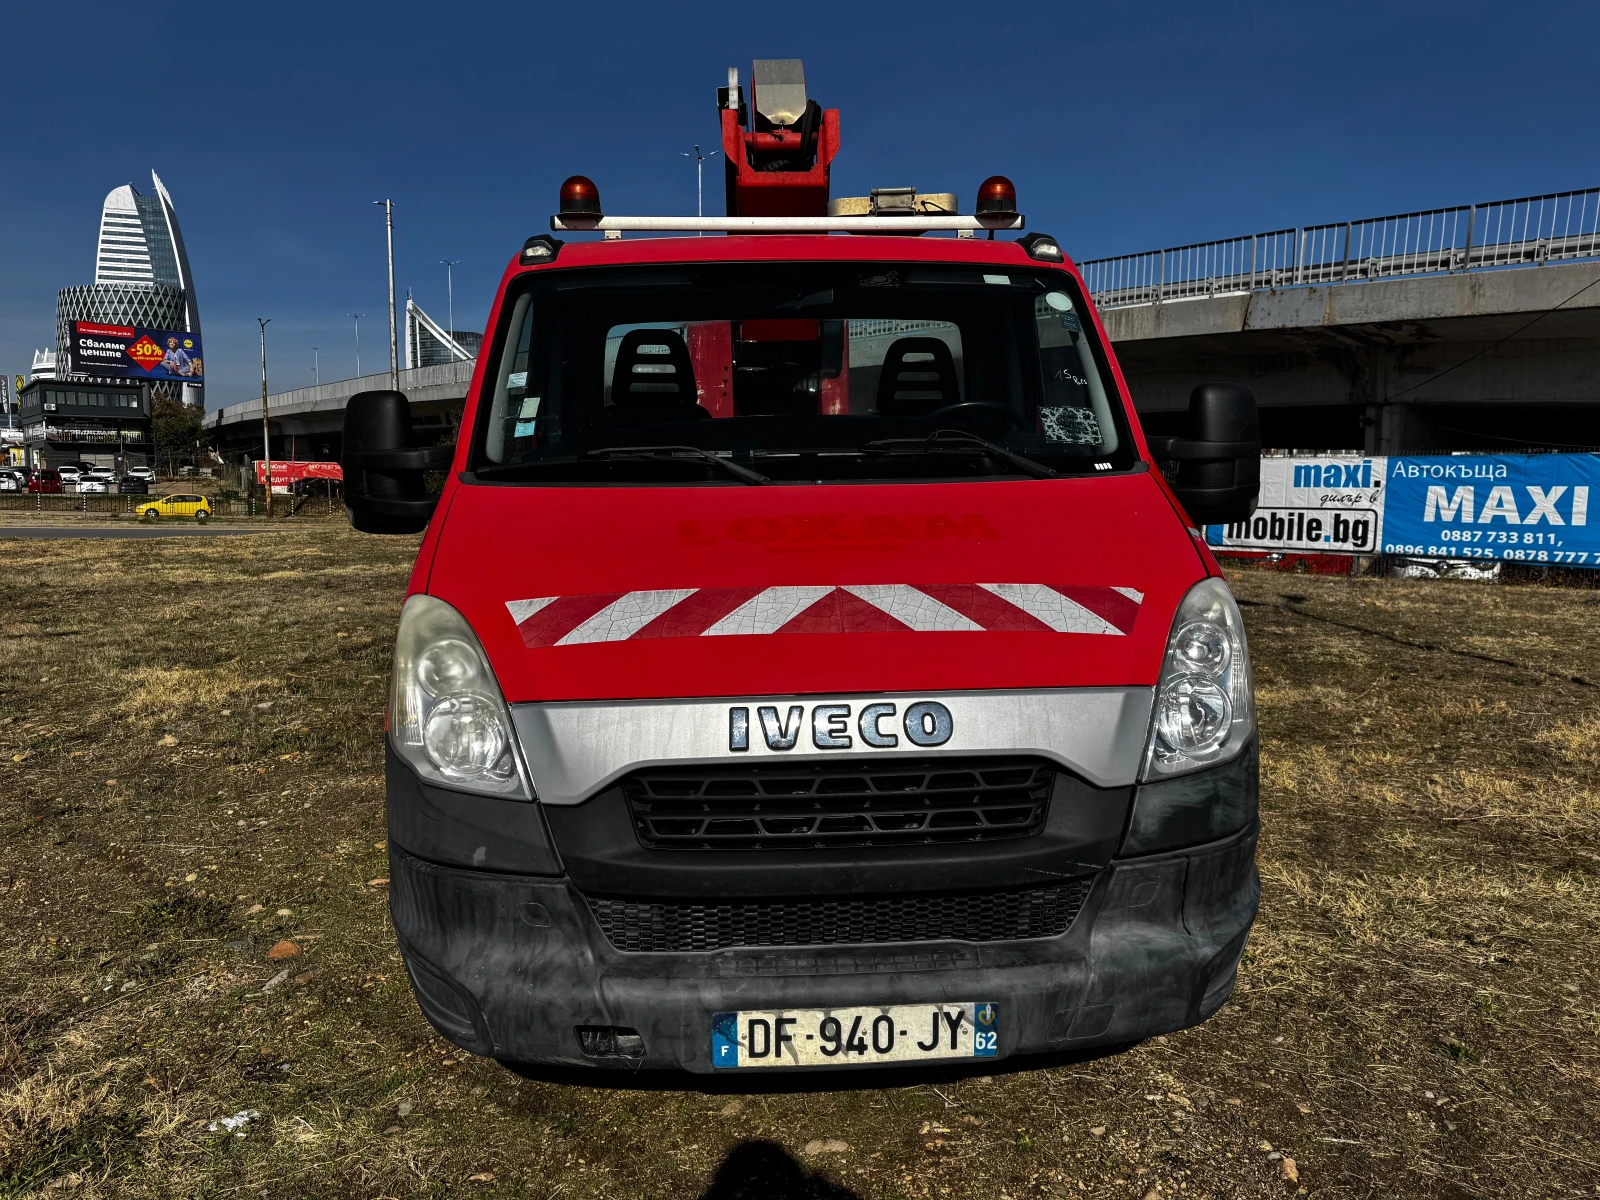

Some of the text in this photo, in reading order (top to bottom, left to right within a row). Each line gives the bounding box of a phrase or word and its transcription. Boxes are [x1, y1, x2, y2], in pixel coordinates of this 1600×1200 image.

[79, 338, 126, 350] Сваляме
[79, 348, 122, 358] цените
[131, 343, 163, 356] -50%
[261, 475, 289, 483] Кедит
[1392, 460, 1507, 481] Автокъща
[1423, 485, 1589, 526] MAXI
[678, 513, 1002, 547] LOXAM
[1227, 512, 1370, 547] mobile.bg
[1440, 530, 1564, 547] 0887 733 811,
[1385, 544, 1424, 555] 0896
[1427, 546, 1457, 557] 841
[1503, 549, 1549, 562] 0878
[1553, 551, 1589, 564] 777
[729, 700, 954, 752] IVECO
[975, 1031, 998, 1050] 62
[720, 1045, 730, 1058] F
